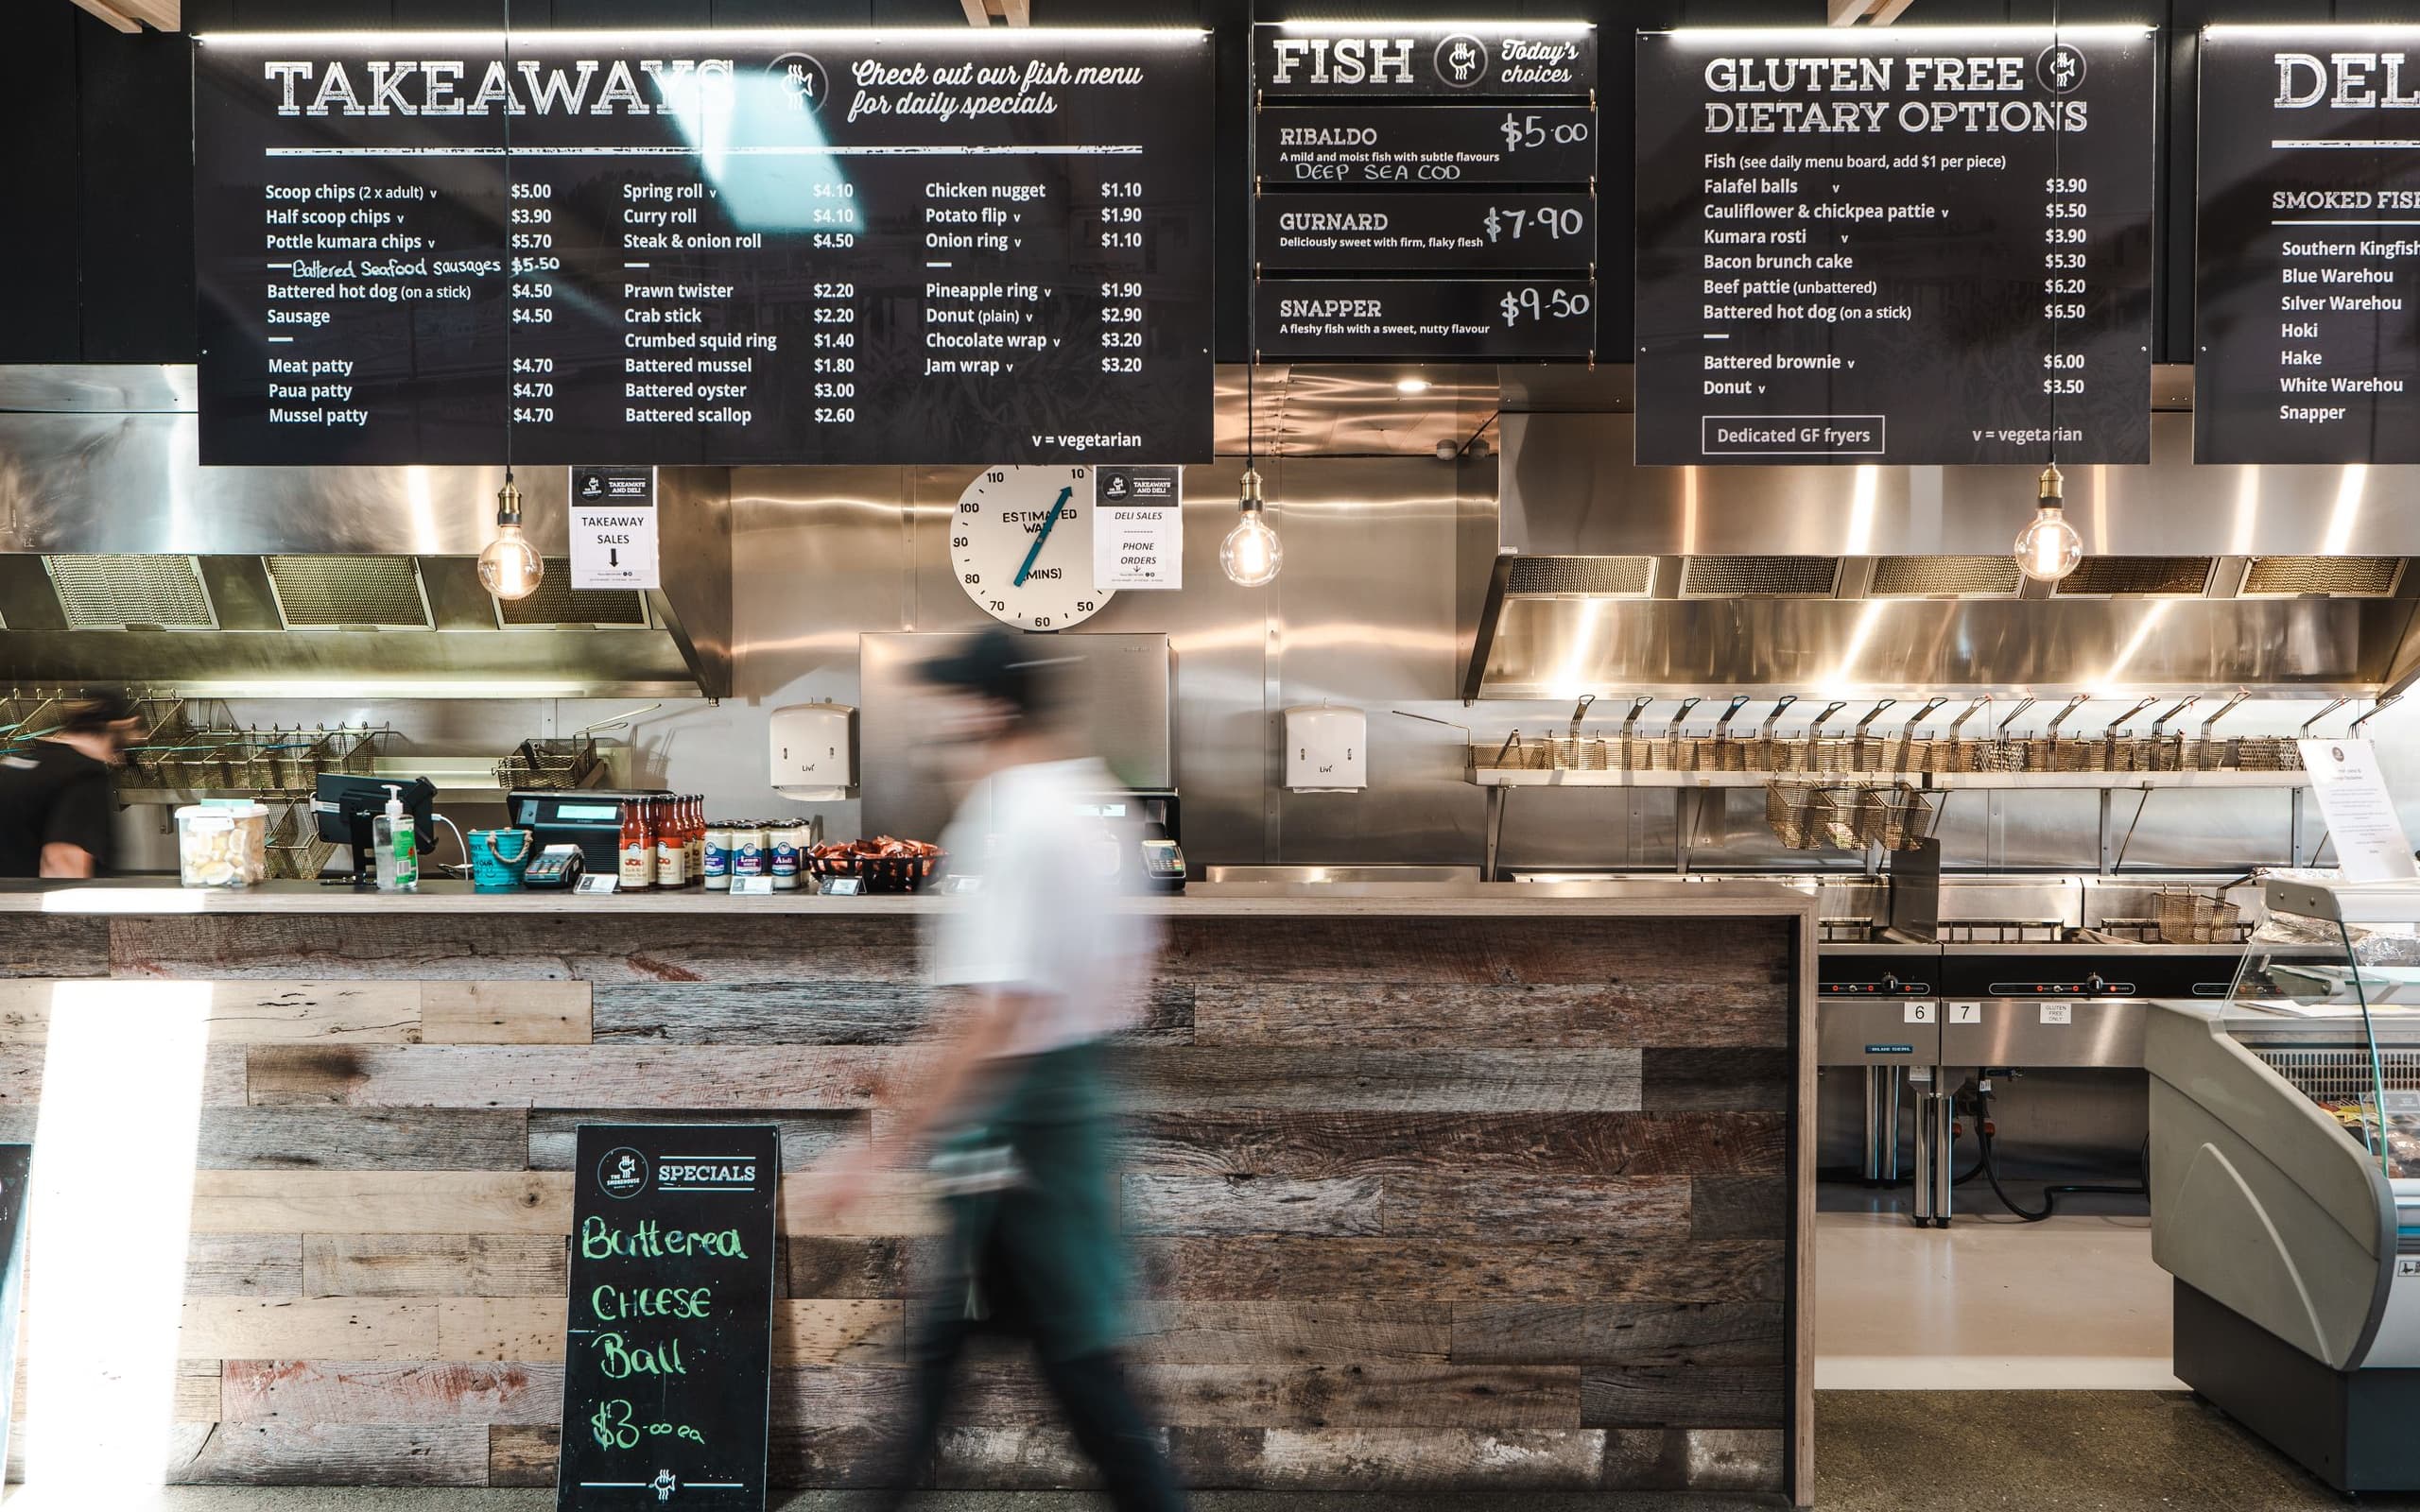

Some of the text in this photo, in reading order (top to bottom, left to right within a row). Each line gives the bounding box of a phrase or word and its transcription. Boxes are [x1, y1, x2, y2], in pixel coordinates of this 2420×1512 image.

[1272, 38, 1415, 84] FISH
[1501, 39, 1580, 66] Today's
[852, 59, 1144, 94] Check out our fish menu
[1501, 64, 1573, 83] choices
[1704, 57, 2024, 93] GLUTEN FREE
[264, 59, 735, 116] TAKEAWAYS
[847, 90, 1058, 123] for daily specials
[1704, 100, 2088, 133] DIETARY OPTIONS
[1280, 128, 1377, 146] RIBALDO
[1280, 151, 1500, 163] A mild and moist fish with subtle flavours
[1704, 153, 2006, 172] Fish (see daily menu board, add $1 per piece)
[1295, 163, 1461, 180] DEEP SEA COD
[265, 183, 552, 203] Scoop chips (2 x adult) v $5.00
[623, 182, 853, 202] Spring roll v $4.10
[925, 181, 1142, 201] Chicken nugget $1.10
[2273, 191, 2373, 209] SMOKED
[925, 207, 1142, 227] Potato flip v $1.90
[1279, 213, 1389, 231] GURNARD
[267, 233, 552, 253] Pottle kumara chips v $5.70
[2282, 240, 2356, 256] Southern
[292, 259, 356, 279] Battered
[361, 258, 427, 276] Seafood
[433, 260, 501, 276] sausages
[1703, 253, 2086, 269] Bacon brunch cake $5.30
[2282, 267, 2394, 284] Blue Warehou
[625, 283, 855, 299] Prawn twister $2.20
[926, 282, 1142, 302] Pineapple ring v $1.90
[1703, 278, 2086, 299] Beef pattie (unbattered) $6.20
[268, 308, 553, 327] Sausage $4.50
[926, 307, 1142, 326] Donut (plain) v $2.90
[1280, 300, 1382, 318] SNAPPER
[2281, 322, 2318, 338] Hoki
[625, 332, 855, 352] Crumbed squid ring $1.40
[2281, 350, 2323, 365] Hake
[268, 357, 553, 377] Meat patty $4.70
[2279, 377, 2403, 392] White Warehou
[2279, 404, 2346, 424] Snapper
[1718, 427, 1871, 447] Dedicated GF fryers
[986, 472, 1005, 484] 110
[1071, 468, 1085, 479] 10
[959, 503, 979, 514] 100
[1115, 511, 1163, 521] DELI SALES
[581, 517, 644, 527] TAKEAWAY
[596, 534, 630, 544] SALES
[953, 536, 969, 548] 90
[1122, 542, 1154, 551] PHONE
[1120, 556, 1157, 565] ORDERS
[964, 574, 980, 584] 80
[990, 600, 1005, 611] 70
[1077, 601, 1094, 612] 50
[1034, 617, 1050, 627] 60
[1914, 1005, 1925, 1020] 6
[1961, 1005, 1970, 1020] 7
[658, 1165, 755, 1181] SPECIALS
[591, 1332, 687, 1379] Ball
